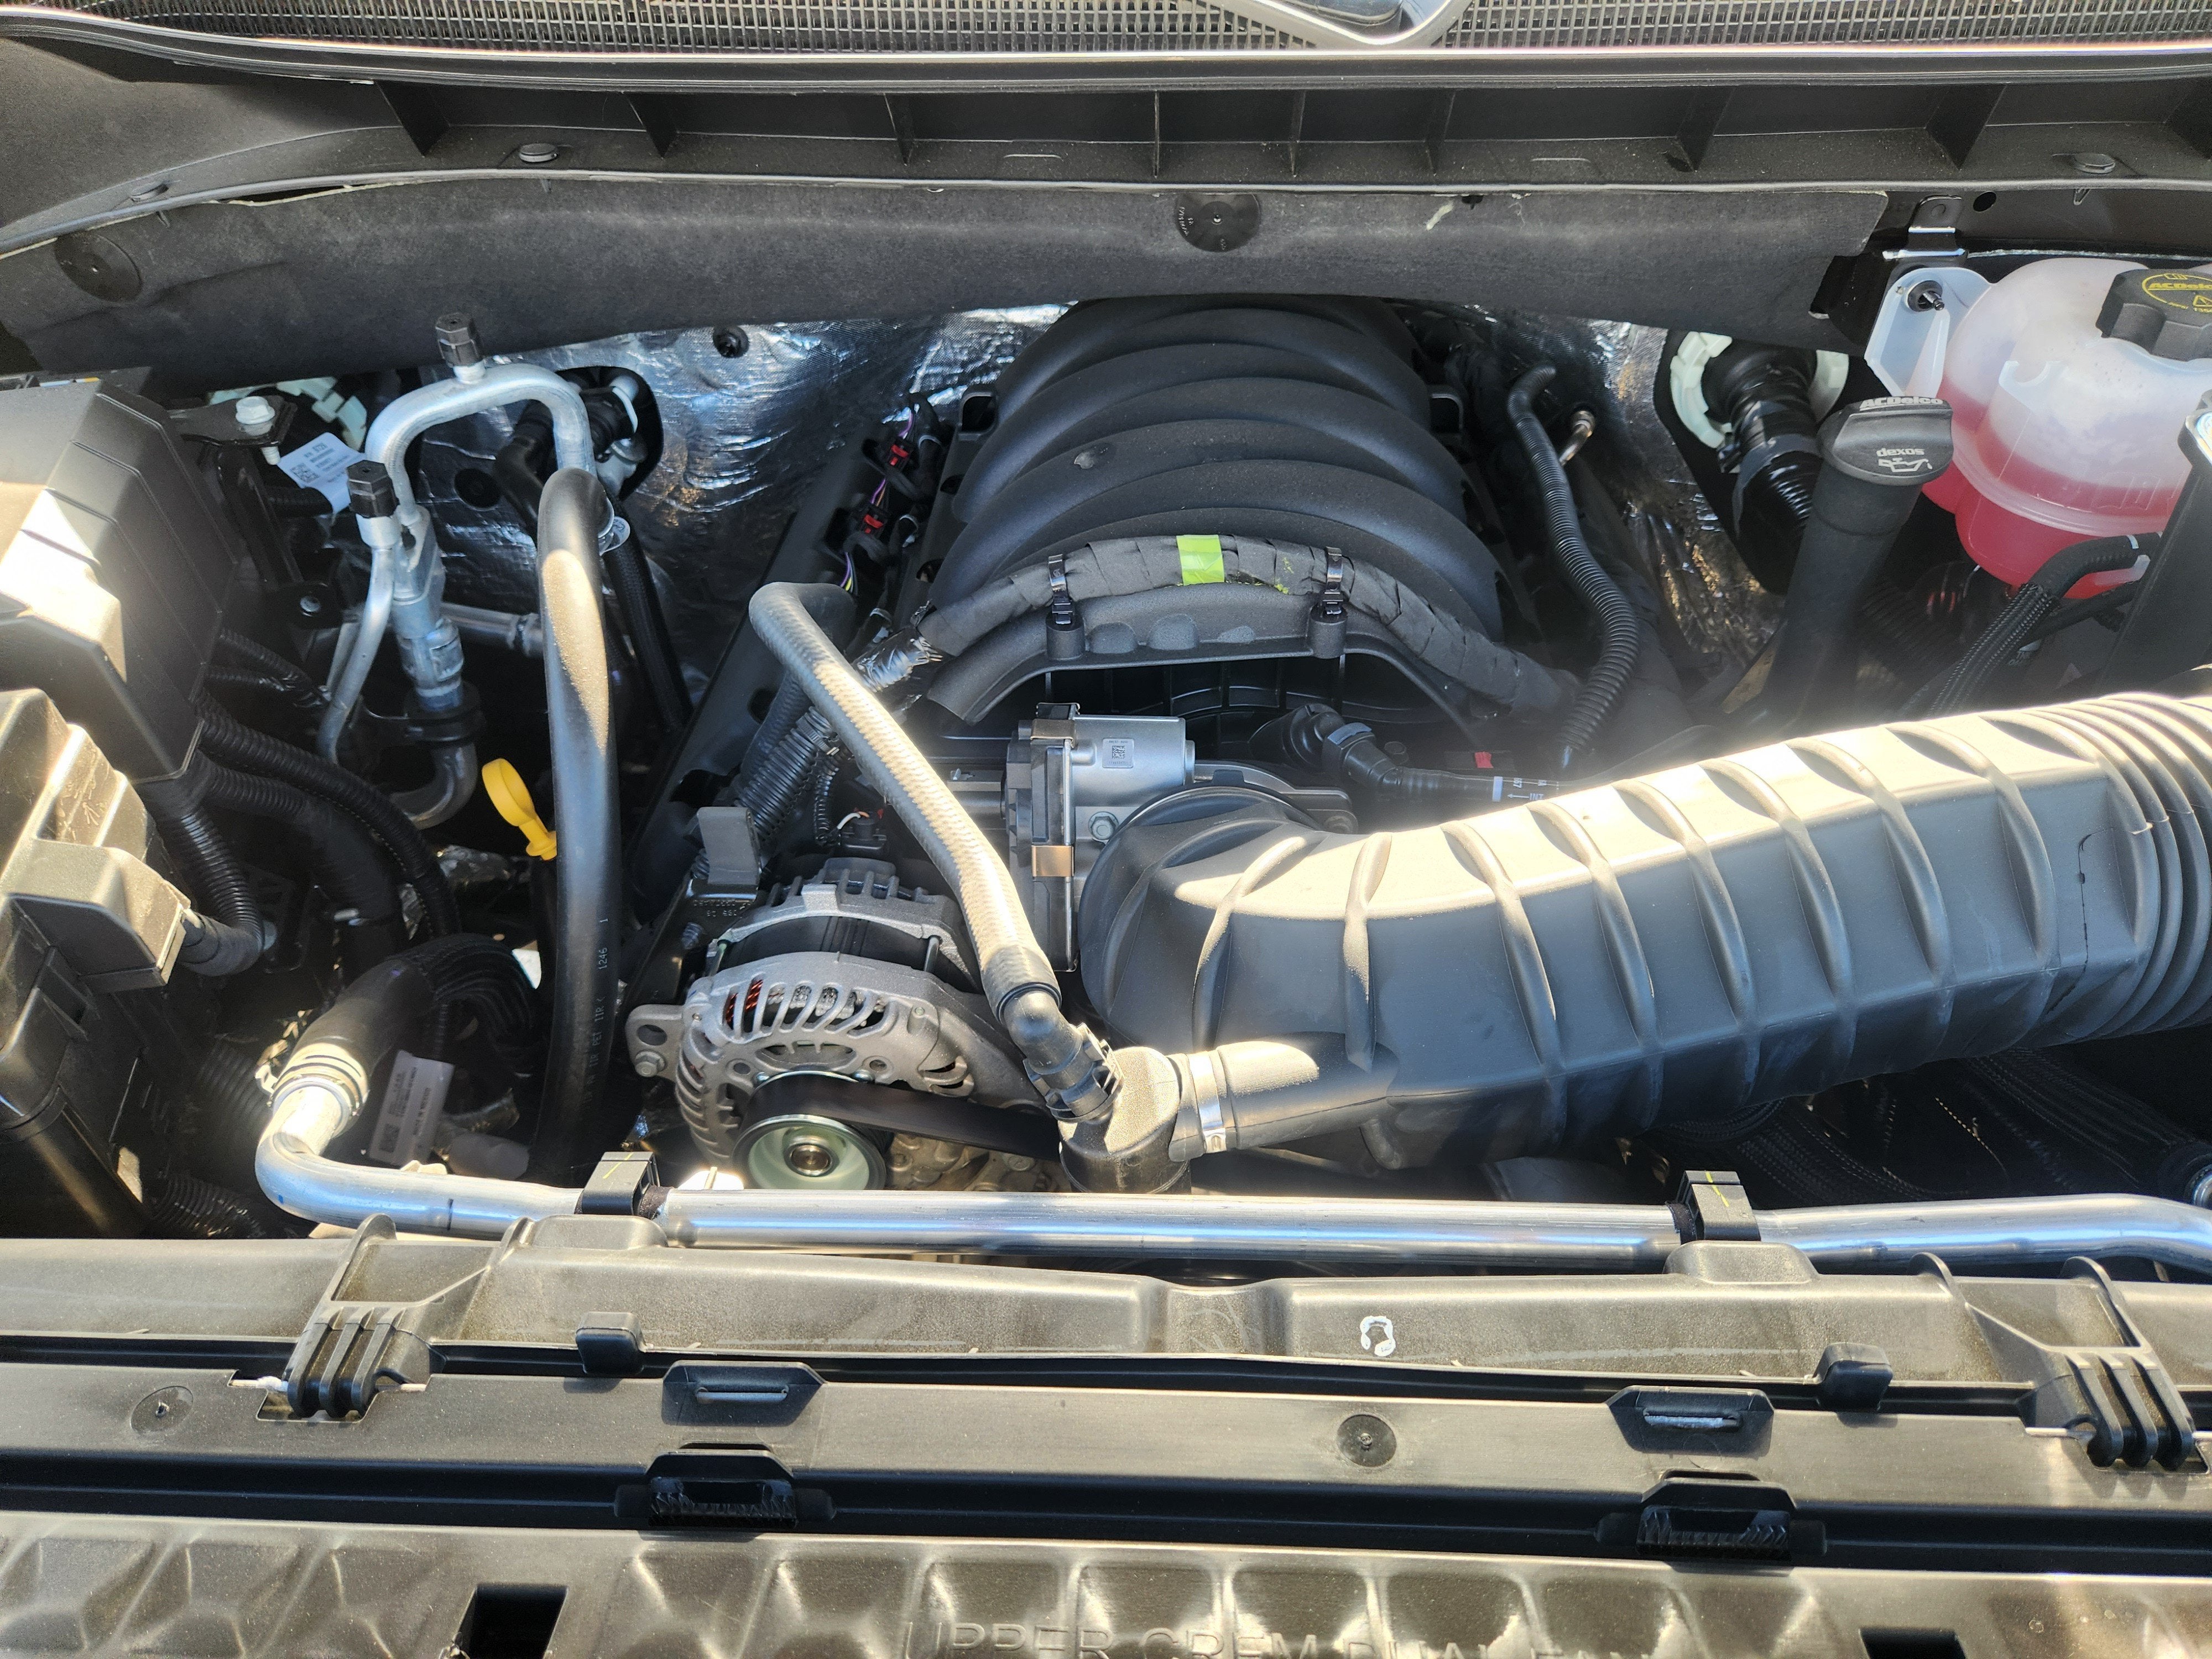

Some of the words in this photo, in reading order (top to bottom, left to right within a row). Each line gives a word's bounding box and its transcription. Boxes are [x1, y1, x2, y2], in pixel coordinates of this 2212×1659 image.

[1859, 397, 1943, 409] ACDelco
[1876, 448, 1924, 457] dexos
[592, 1031, 602, 1046] PET
[598, 947, 608, 969] 1246
[902, 1622, 1114, 1659] UPPER
